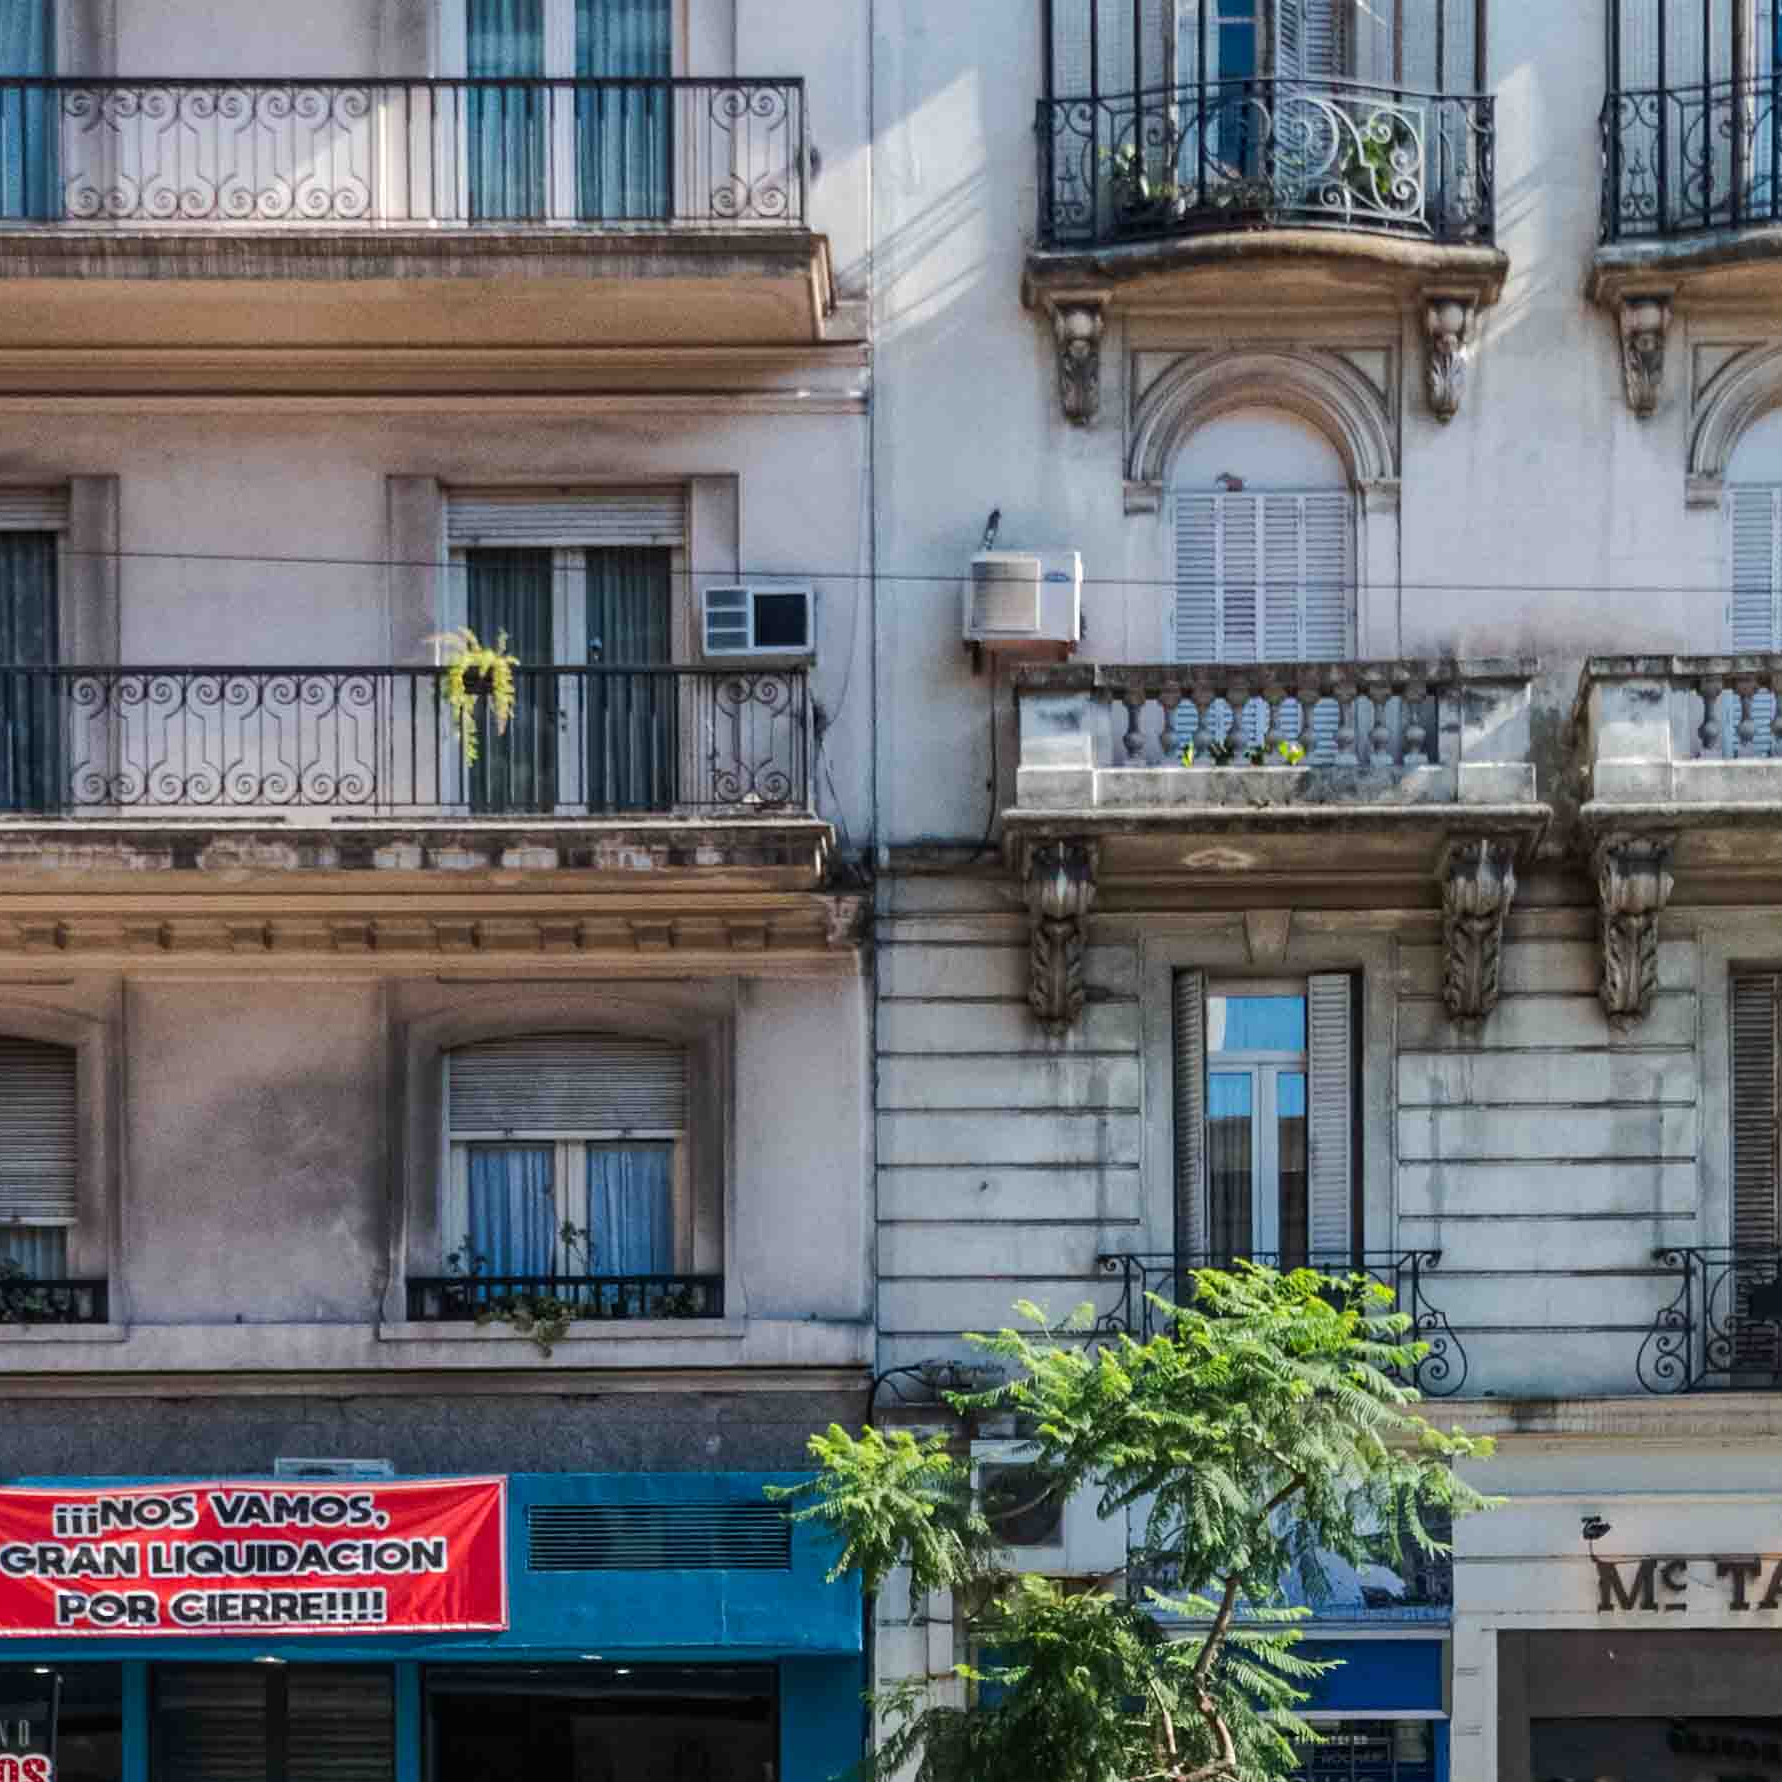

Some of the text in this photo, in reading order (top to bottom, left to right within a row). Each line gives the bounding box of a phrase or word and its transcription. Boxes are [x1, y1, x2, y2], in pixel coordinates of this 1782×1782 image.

[210, 1494, 389, 1529] VAMOS,
[149, 1537, 447, 1577] LIQUIDACION
[56, 1588, 388, 1626] POR CIERRE!!!!
